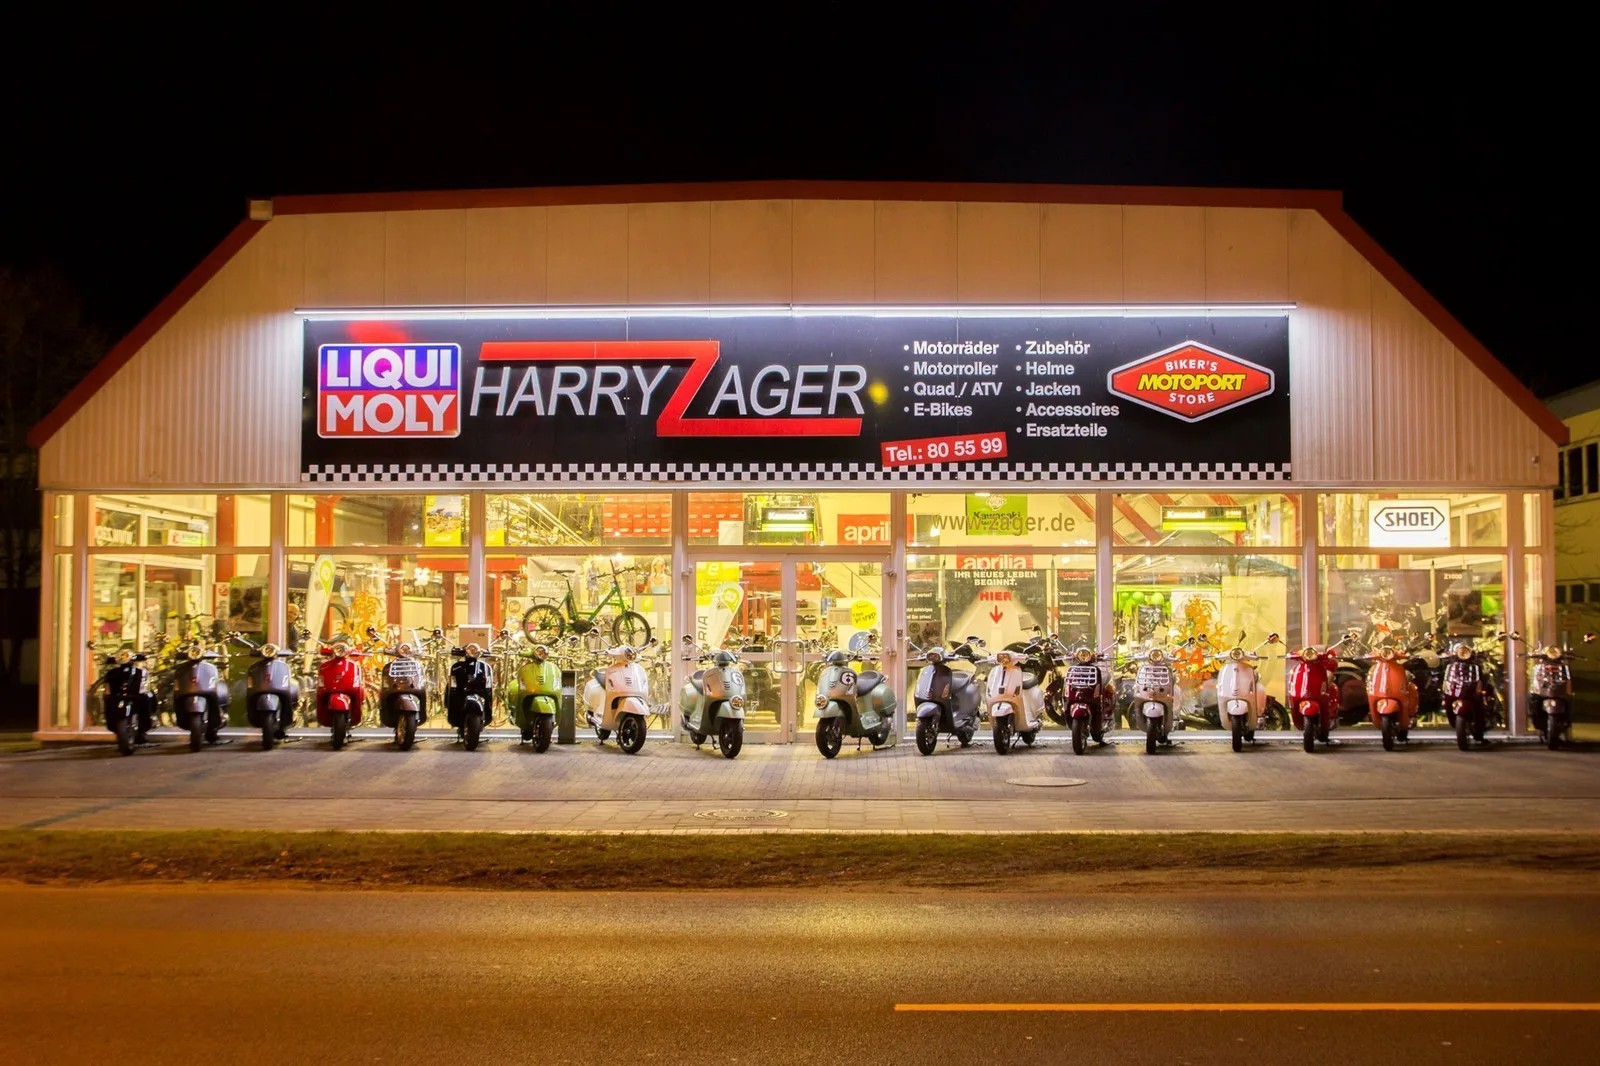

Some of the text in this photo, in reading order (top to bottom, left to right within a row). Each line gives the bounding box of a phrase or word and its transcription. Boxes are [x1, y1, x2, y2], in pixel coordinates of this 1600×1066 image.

[913, 341, 999, 355] Motorräder
[1025, 341, 1091, 355] Zubehör
[326, 350, 452, 388] LIQUI
[913, 361, 998, 375] Motorroller
[1026, 361, 1075, 375] Helme
[1165, 359, 1218, 371] BIKER'S
[913, 382, 955, 396] Quad
[971, 382, 1003, 396] ATV
[1025, 382, 1081, 395] Jacken
[1136, 373, 1247, 391] MOTOPORT
[470, 366, 670, 416] HARRY
[1169, 392, 1215, 404] STORE
[326, 394, 456, 432] MOLY
[914, 402, 973, 416] E-Bikes
[1025, 402, 1120, 416] Accessoires
[1026, 423, 1107, 437] Ersatzteile
[886, 438, 1003, 462] Tel.: 80 55 99
[932, 513, 1076, 537] www.zager.de
[1384, 512, 1435, 527] SHOEI
[844, 521, 890, 545] april
[963, 554, 1026, 569] aprilia
[954, 571, 1037, 579] IHR NEUES LEBEN
[979, 591, 1012, 601] HIER
